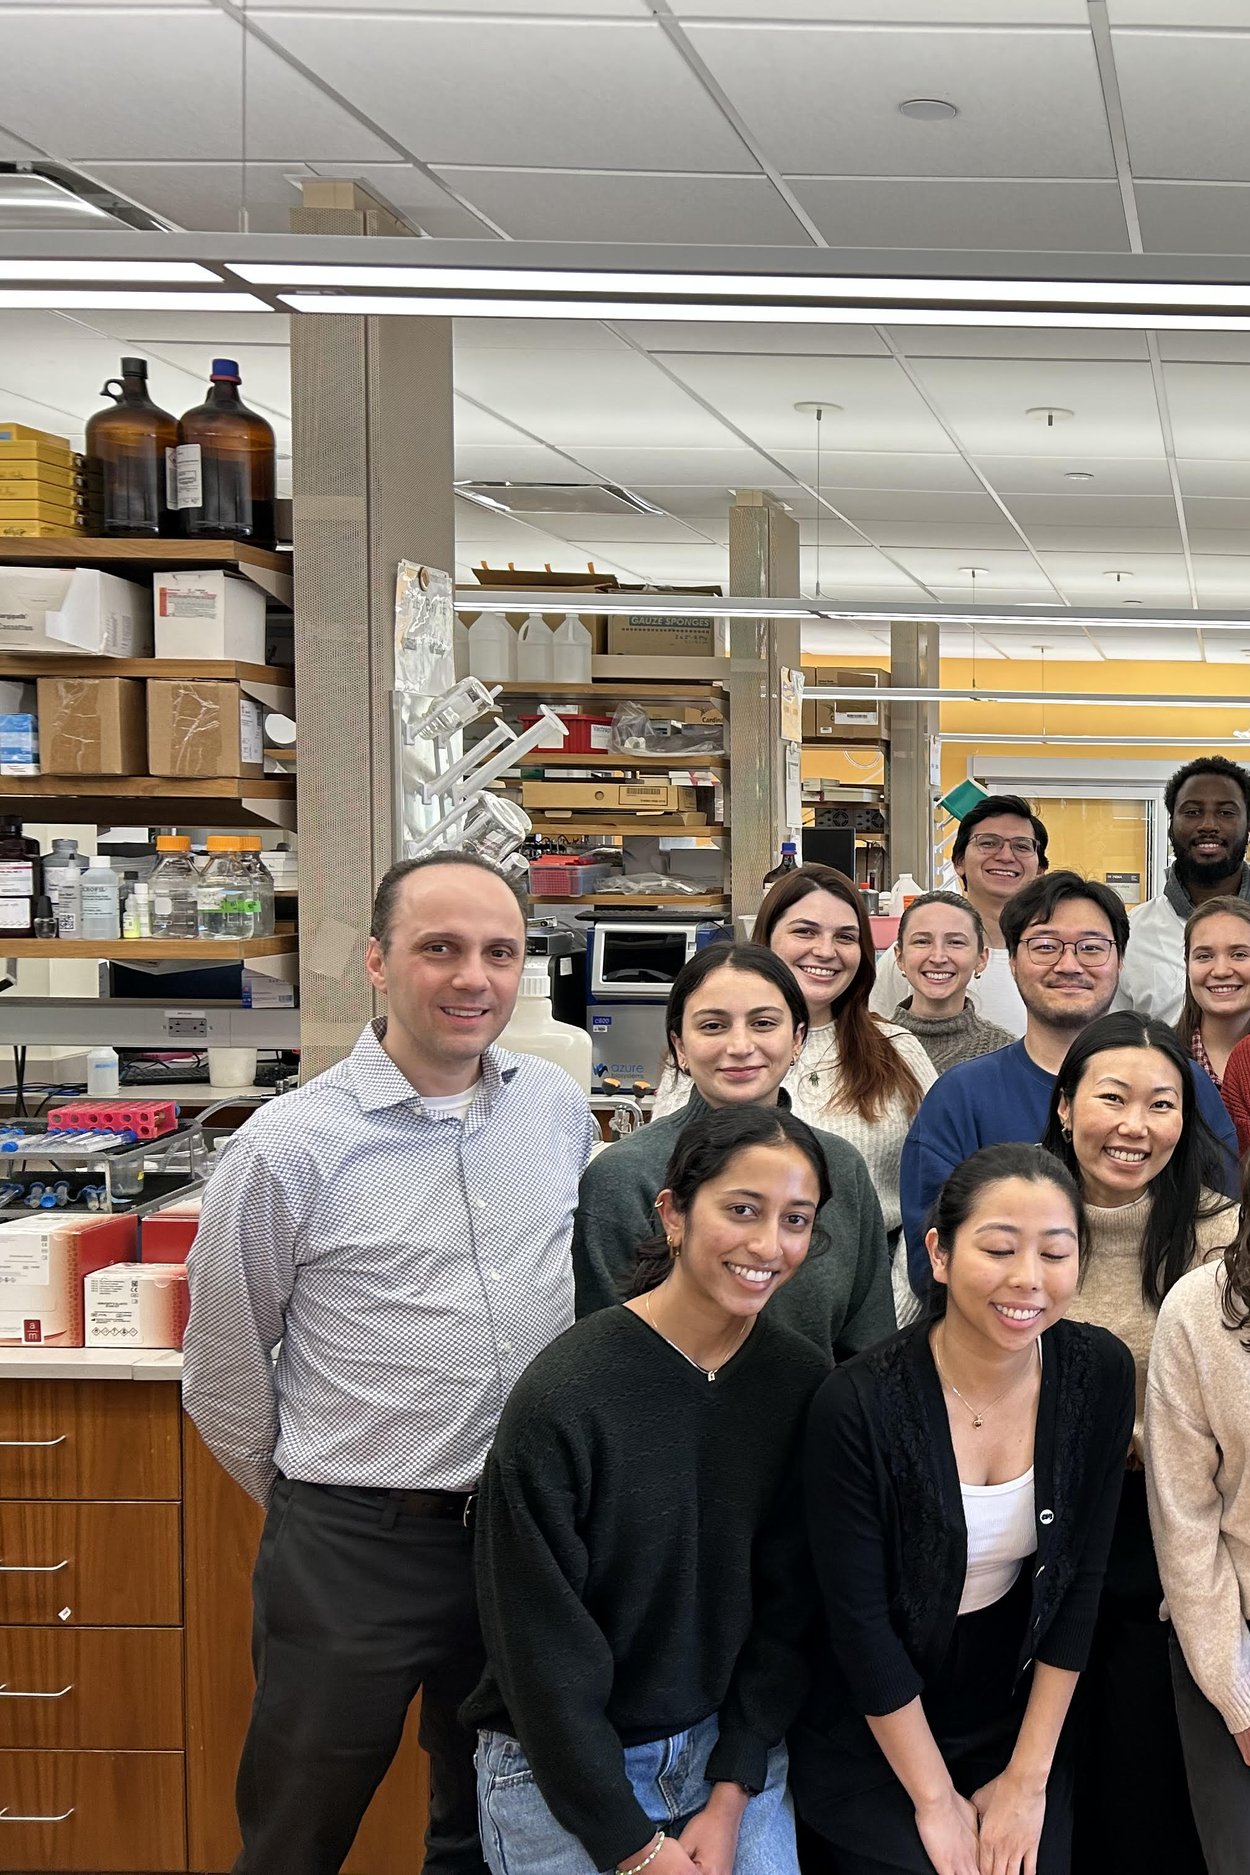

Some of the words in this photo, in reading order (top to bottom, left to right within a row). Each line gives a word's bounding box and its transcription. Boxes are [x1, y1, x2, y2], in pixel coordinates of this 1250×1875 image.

[631, 616, 664, 625] GAUZE
[665, 617, 710, 627] SPONGES
[702, 715, 721, 723] Cardin
[611, 1064, 645, 1073] azure
